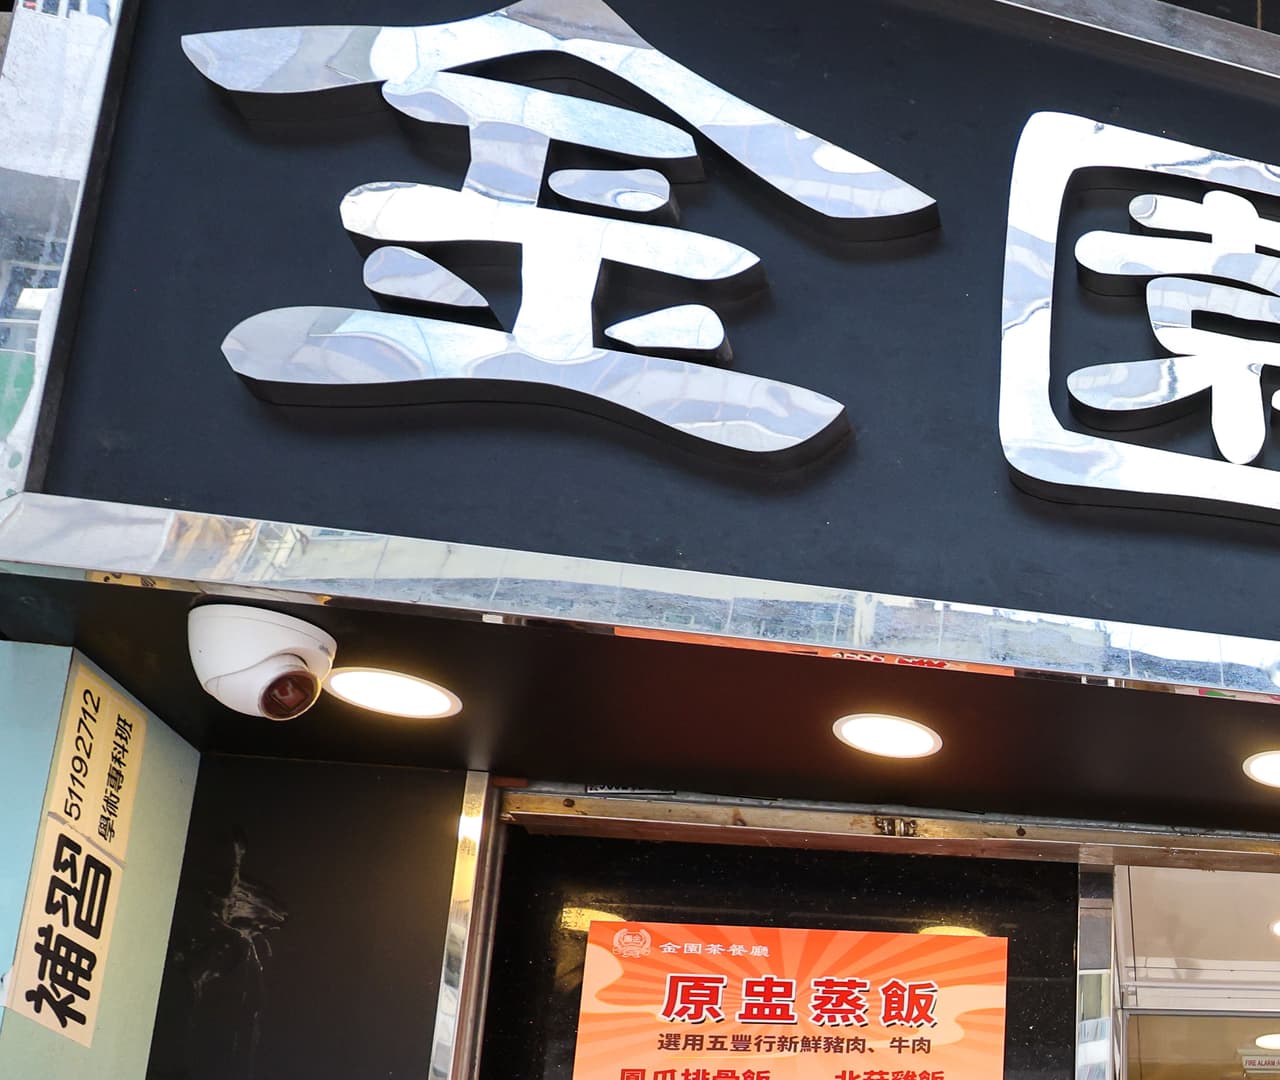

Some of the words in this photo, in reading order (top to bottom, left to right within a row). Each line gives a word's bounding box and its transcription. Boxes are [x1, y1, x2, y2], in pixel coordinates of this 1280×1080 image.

[97, 713, 133, 843] 學術專科班
[25, 833, 111, 1028] 補習
[658, 942, 770, 958] 金園茶餐廳
[662, 974, 938, 1027] 原盅蒸飯
[657, 1033, 931, 1055] 選用五豐行新鮮豬肉、牛肉
